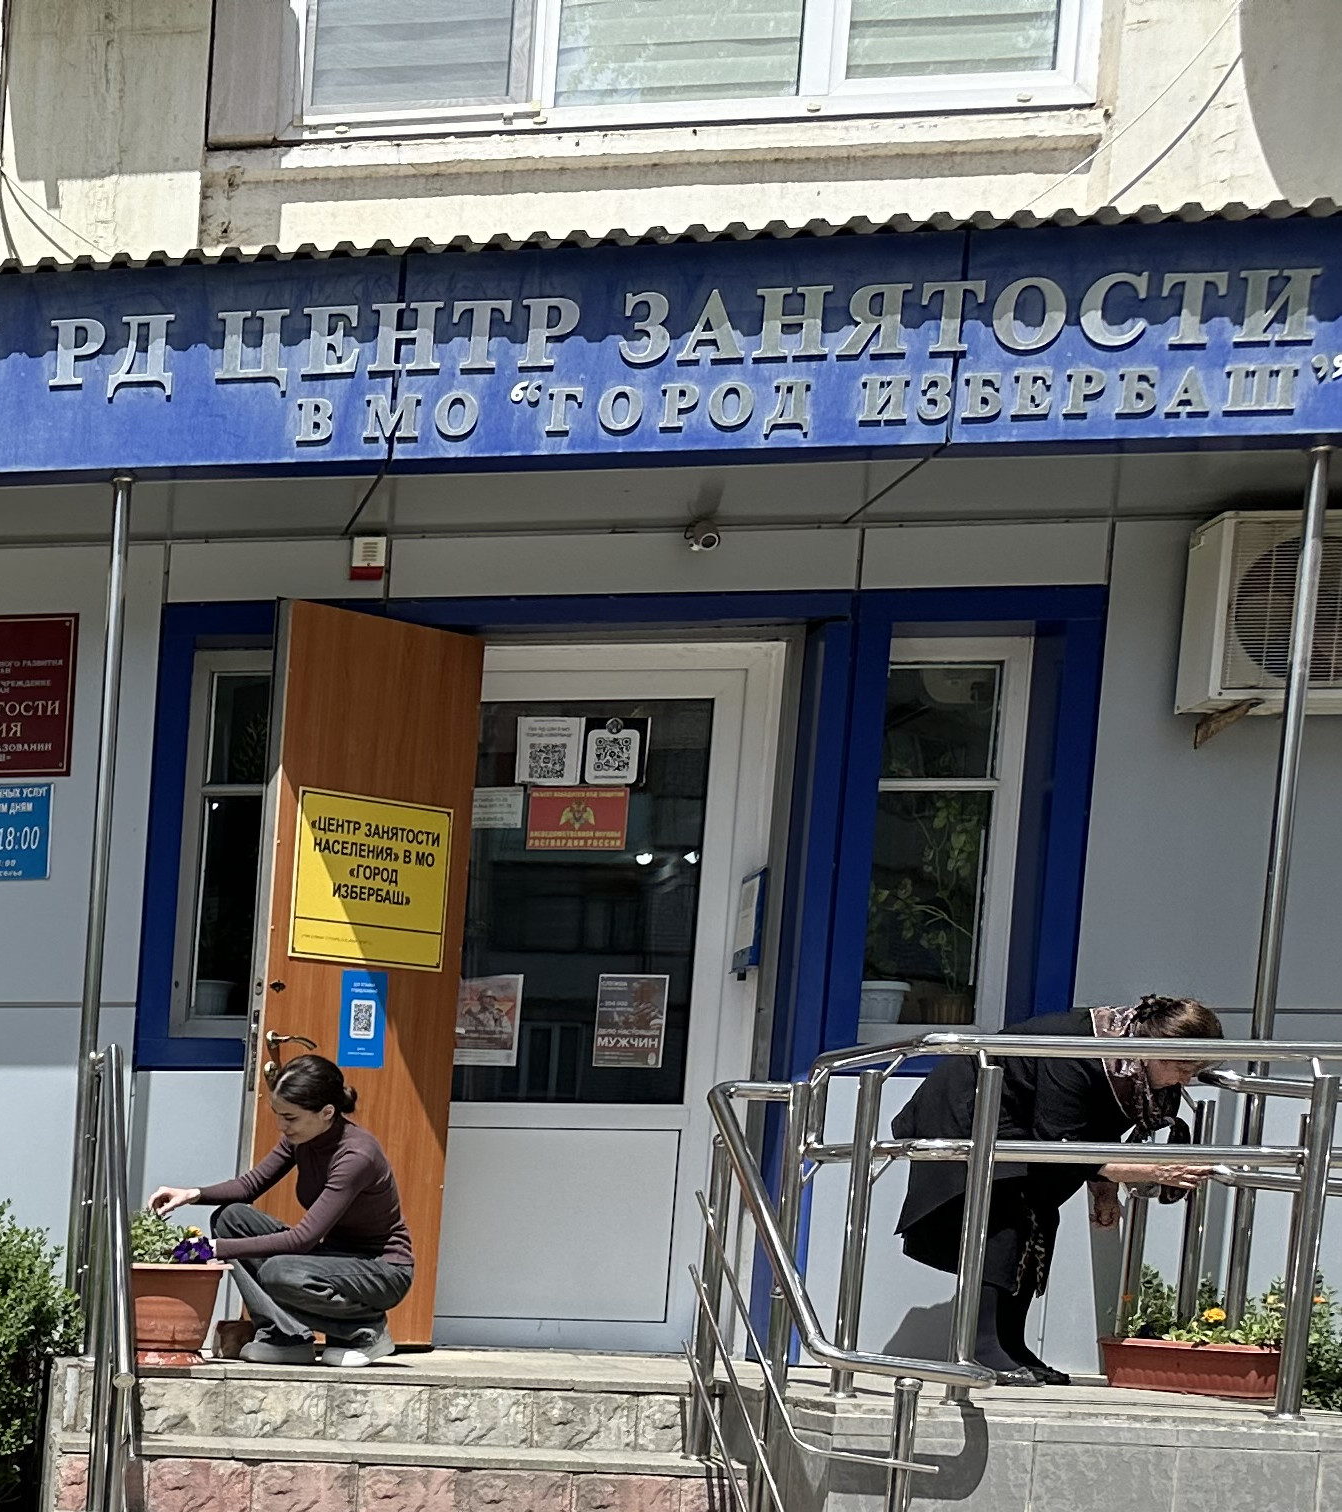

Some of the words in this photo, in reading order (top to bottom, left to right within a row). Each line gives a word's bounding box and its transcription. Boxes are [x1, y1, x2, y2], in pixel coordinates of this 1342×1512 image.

[49, 313, 176, 401] РД
[216, 296, 580, 397] ЦЕНТР
[619, 267, 1323, 366] ЗАНЯТОСТИ
[295, 397, 334, 445] В
[363, 391, 479, 444] МО
[22, 786, 48, 798] УСЛУГ
[9, 802, 33, 815] ДНЯМ
[310, 815, 362, 838] «ЦЕНТР
[364, 822, 441, 848] ЗАНЯТОСТИ
[313, 836, 399, 863] НАСЕЛЕНИЯ»
[403, 850, 412, 864] В
[415, 850, 435, 868] МО
[349, 863, 399, 886] «ГОРОД
[332, 881, 411, 906] ИЗБЕРБАШ»
[597, 1036, 658, 1048] МУЖЧИН
